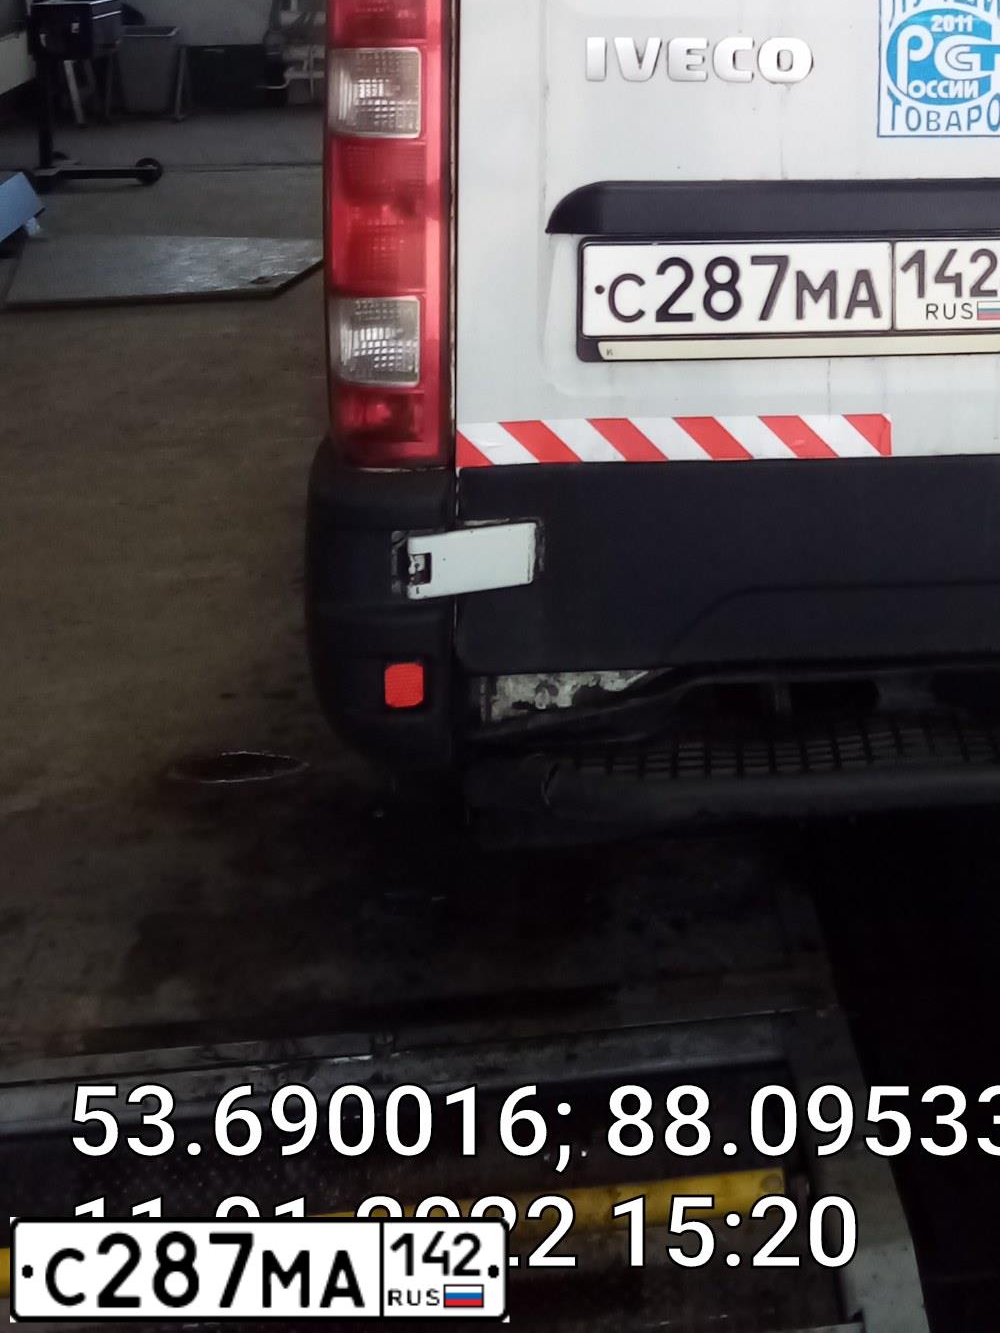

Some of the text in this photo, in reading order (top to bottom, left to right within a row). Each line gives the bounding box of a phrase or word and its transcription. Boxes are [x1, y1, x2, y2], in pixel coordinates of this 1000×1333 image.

[585, 36, 813, 83] IVECO
[900, 248, 998, 299] 142
[925, 301, 974, 320] RUS
